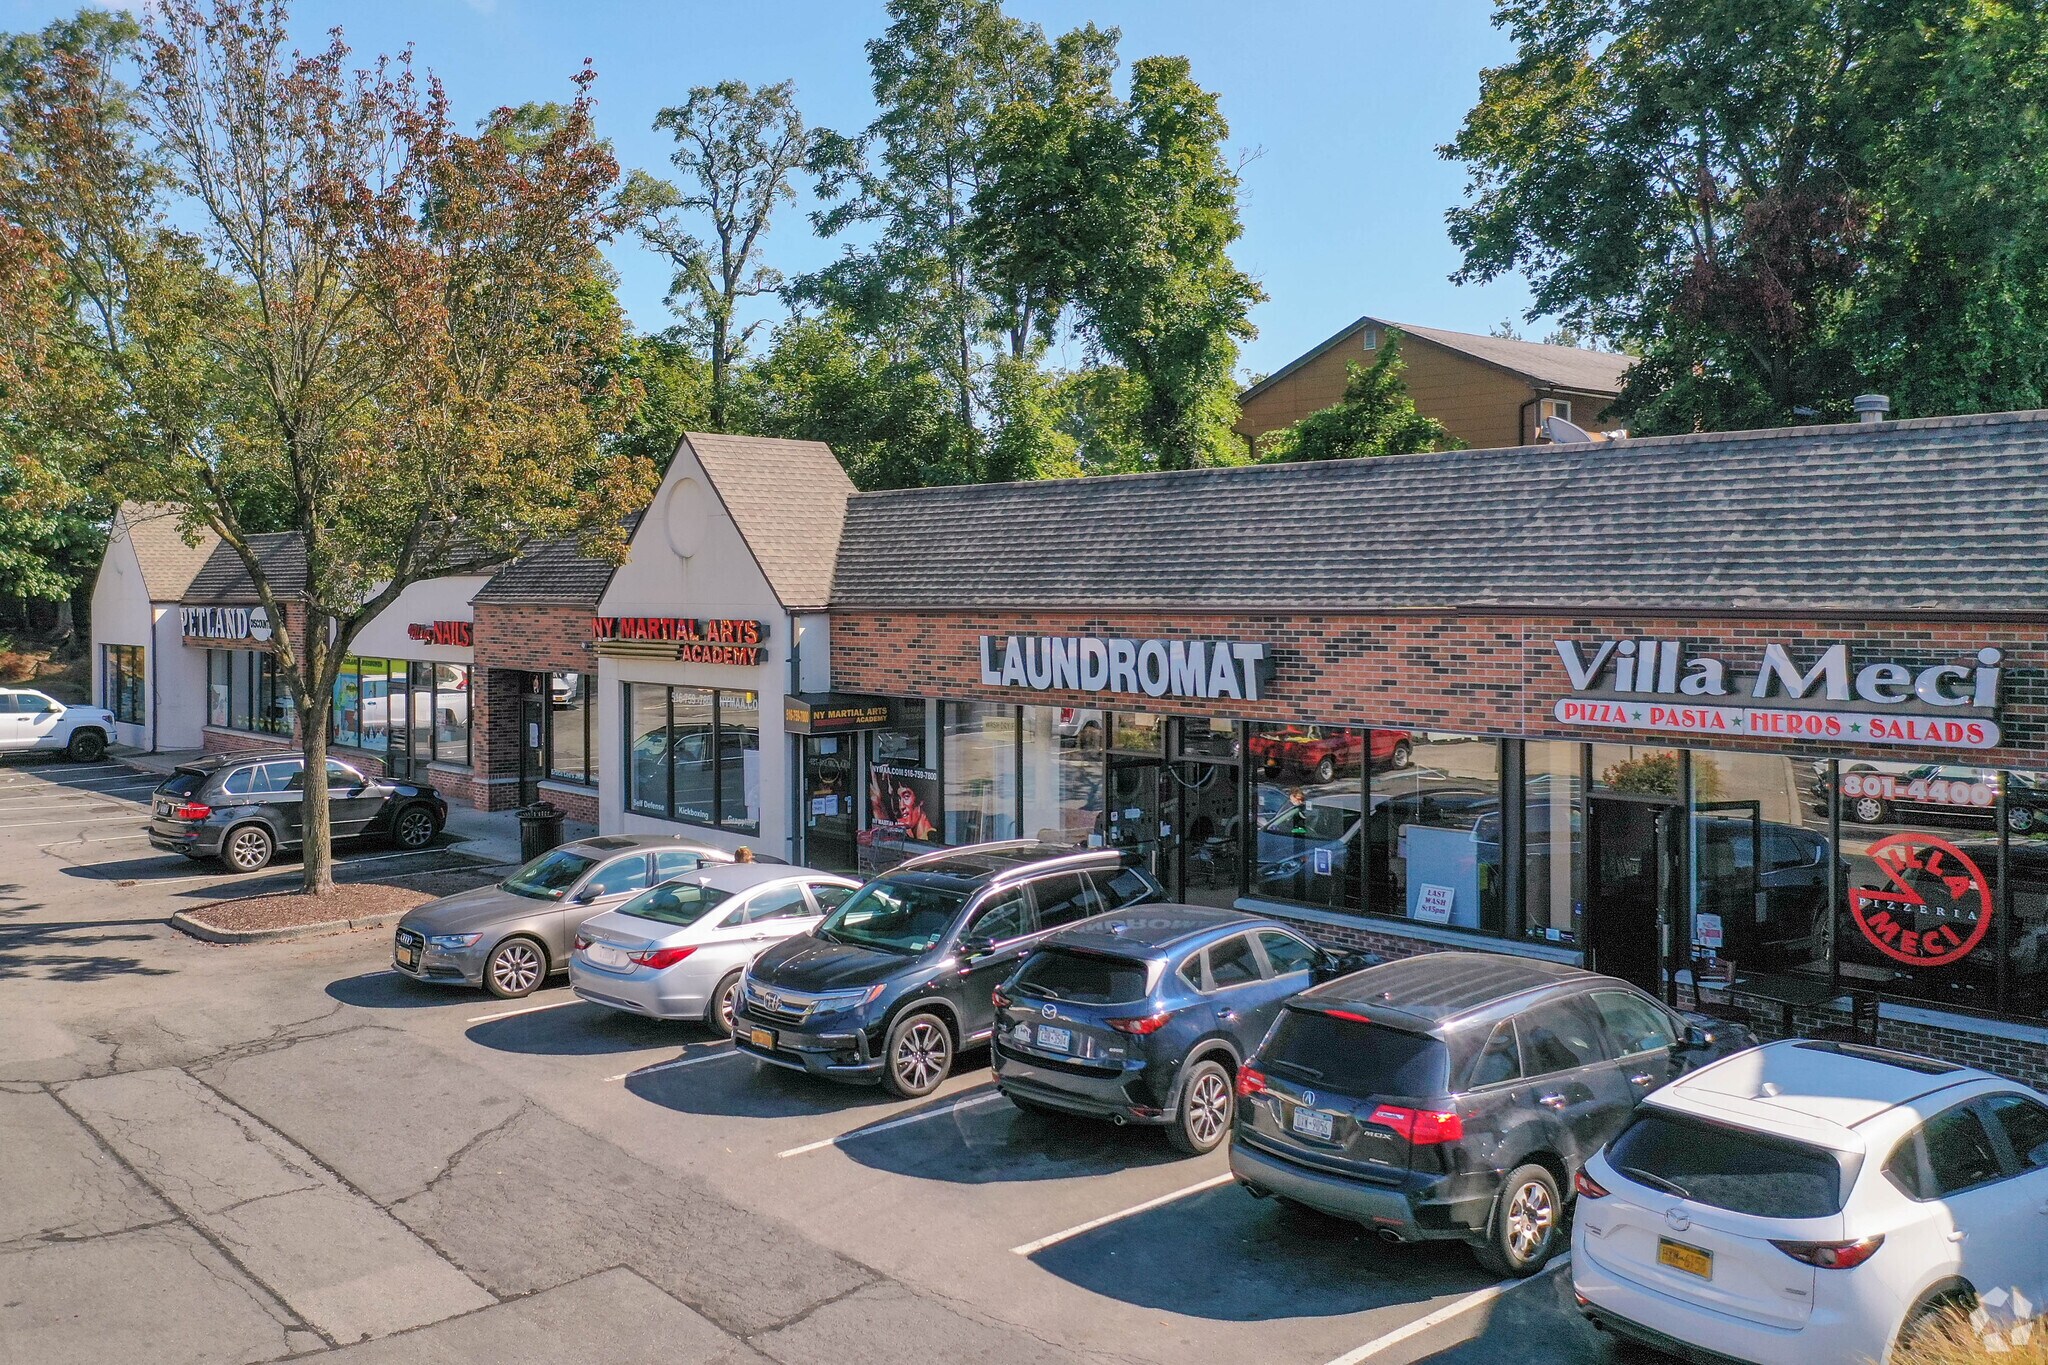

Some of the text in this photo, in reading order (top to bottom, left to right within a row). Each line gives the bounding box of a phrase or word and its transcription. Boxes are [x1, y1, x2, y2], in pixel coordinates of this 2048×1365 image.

[180, 607, 248, 639] PETLAND
[433, 620, 471, 647] NAILS
[591, 617, 760, 645] NY MARTIAL ARTS
[682, 644, 759, 666] ACADEMY
[979, 635, 1266, 701] LAUNDROMAT
[1553, 639, 2002, 708] Villa Meci
[813, 707, 888, 720] NY MARTIAL ARTS
[855, 715, 888, 724] ACADEMY
[1563, 702, 1986, 745] PIZZA PASTA HEROS SALADS
[1843, 775, 1994, 807] 801-4400
[633, 798, 666, 811] Self Defense
[678, 806, 709, 821] Kickboxing
[1424, 896, 1447, 907] WASH
[1427, 889, 1446, 898] LAST
[1859, 896, 1979, 921] PIZZERIA
[1866, 911, 1963, 955] MECI
[1363, 1130, 1393, 1141] MDX
